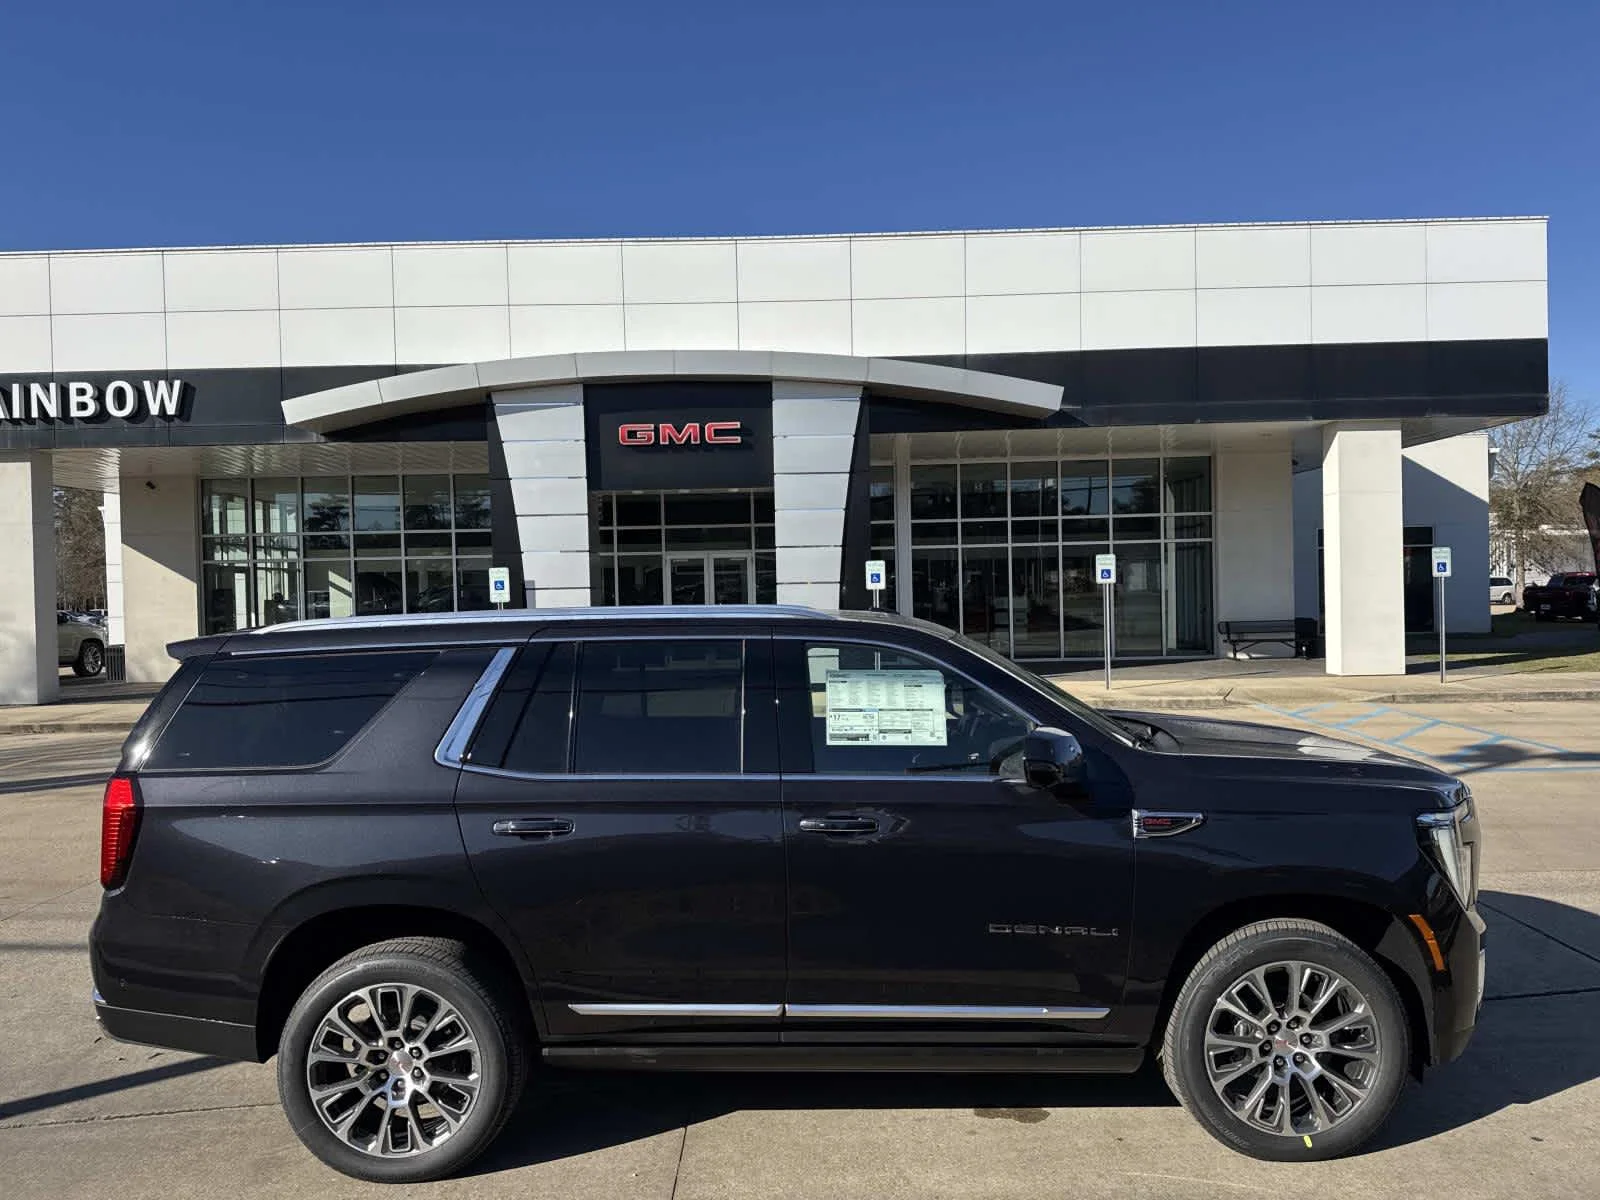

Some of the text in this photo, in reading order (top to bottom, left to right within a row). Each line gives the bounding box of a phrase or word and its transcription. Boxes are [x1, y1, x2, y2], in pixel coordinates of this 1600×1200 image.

[0, 380, 181, 419] INBOW
[619, 421, 741, 445] GMC
[989, 923, 1119, 936] DENALI
